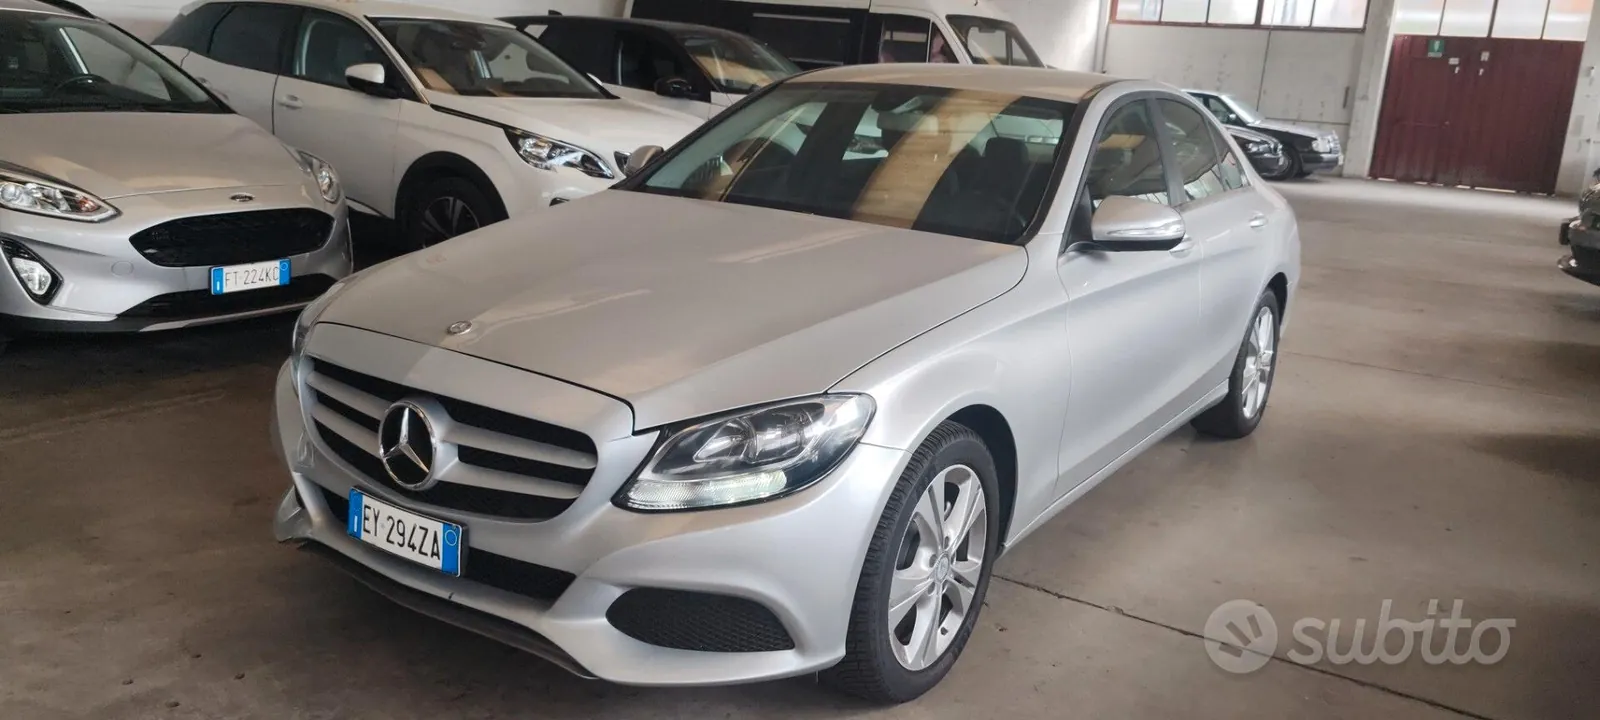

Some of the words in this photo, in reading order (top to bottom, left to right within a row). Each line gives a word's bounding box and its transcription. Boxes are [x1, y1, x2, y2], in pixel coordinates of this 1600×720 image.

[225, 271, 239, 288] FT
[363, 504, 380, 537] EY
[386, 515, 441, 561] 294ZA
